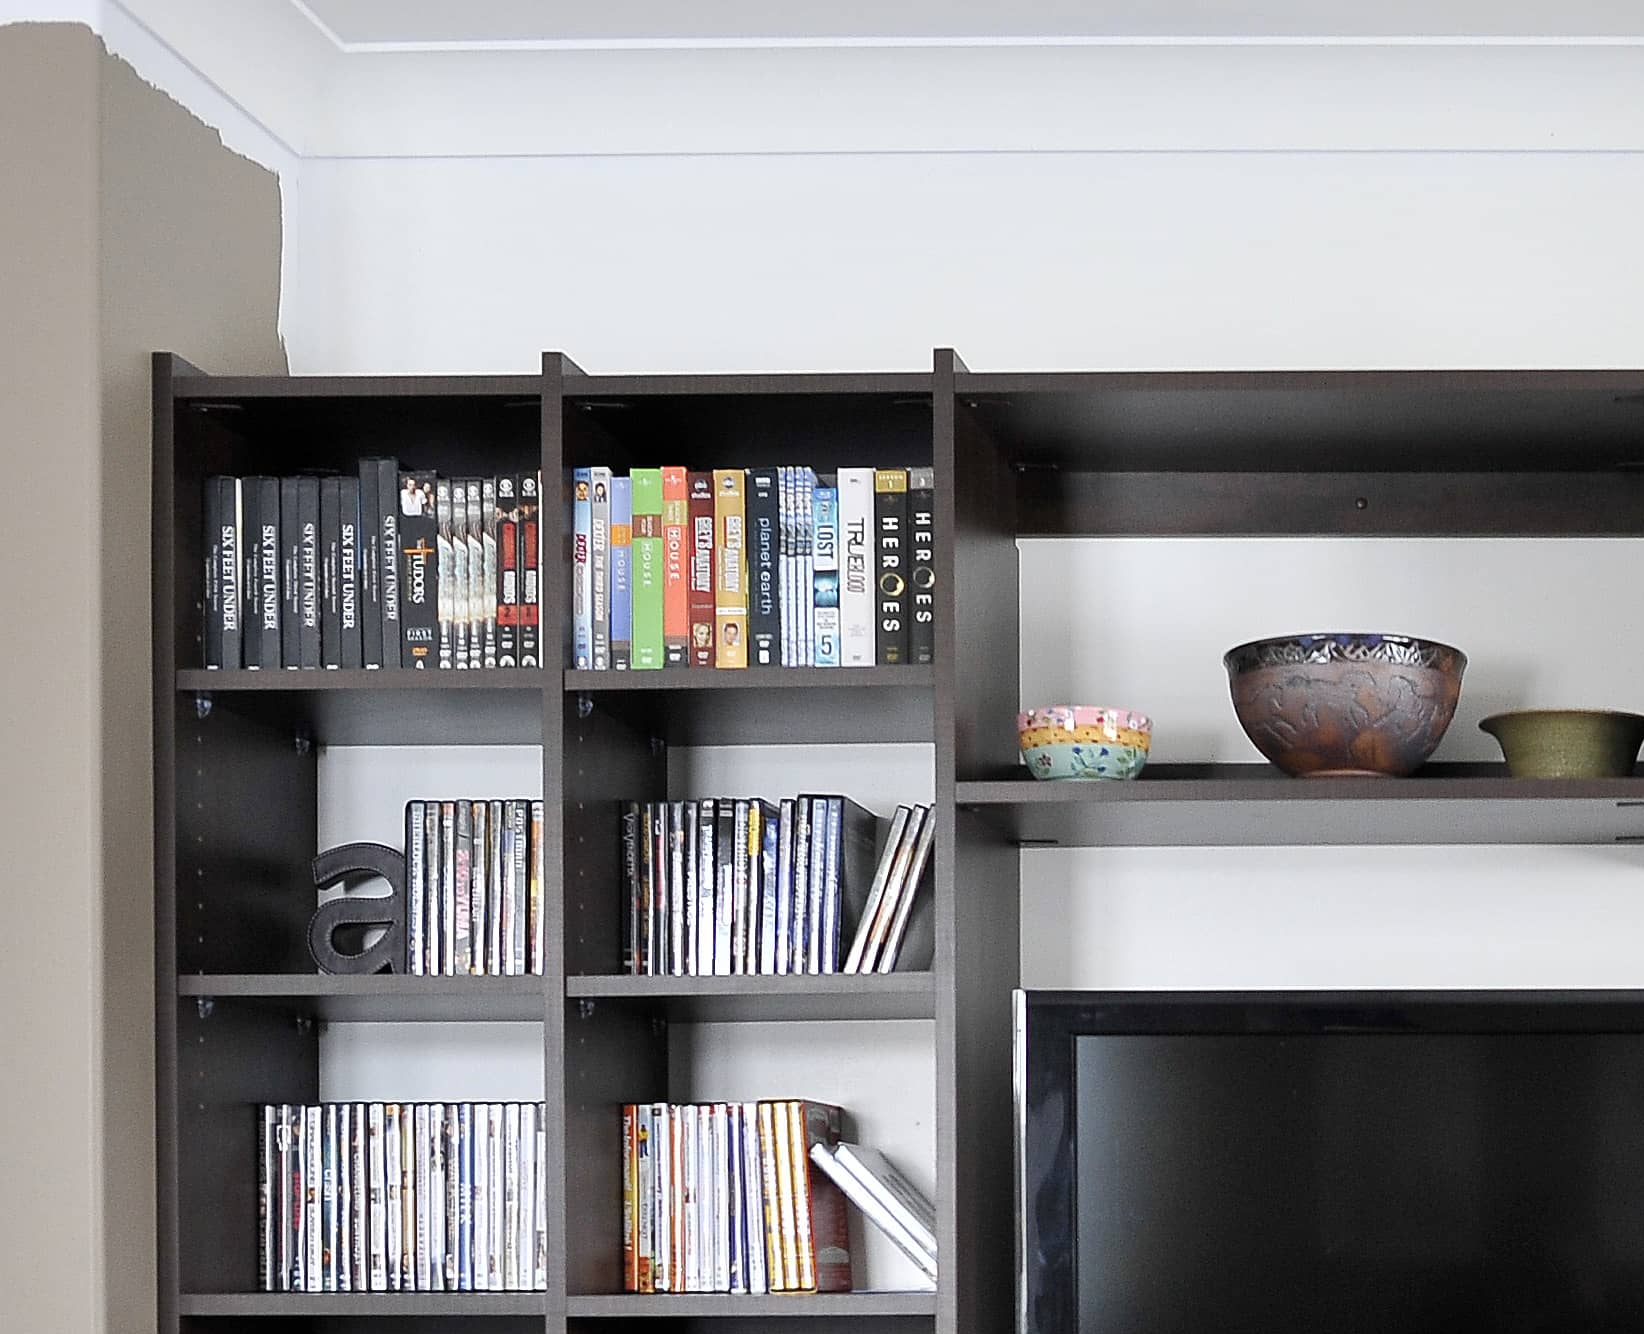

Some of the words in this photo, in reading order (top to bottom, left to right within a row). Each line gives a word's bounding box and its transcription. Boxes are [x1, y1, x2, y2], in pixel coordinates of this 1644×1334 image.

[222, 526, 233, 548] SIX
[263, 526, 274, 546] SIX
[304, 523, 313, 543] SIX
[343, 524, 353, 546] SIX
[384, 516, 394, 537] SIX
[759, 518, 772, 568] planet
[817, 525, 833, 559] LOST
[223, 551, 234, 582] FEET
[264, 550, 274, 581] FEET
[343, 549, 353, 580] FEET
[668, 528, 680, 580] HOUSE
[880, 517, 905, 632] HEROES
[913, 513, 935, 622] HEROES
[385, 575, 396, 619] UNDER
[413, 555, 424, 603] TUDORS
[760, 571, 772, 615] earth
[224, 586, 235, 630] UNDER
[264, 584, 276, 629] UNDER
[304, 582, 315, 627] UNDER
[343, 584, 354, 628] UNDER
[821, 635, 832, 655] 5
